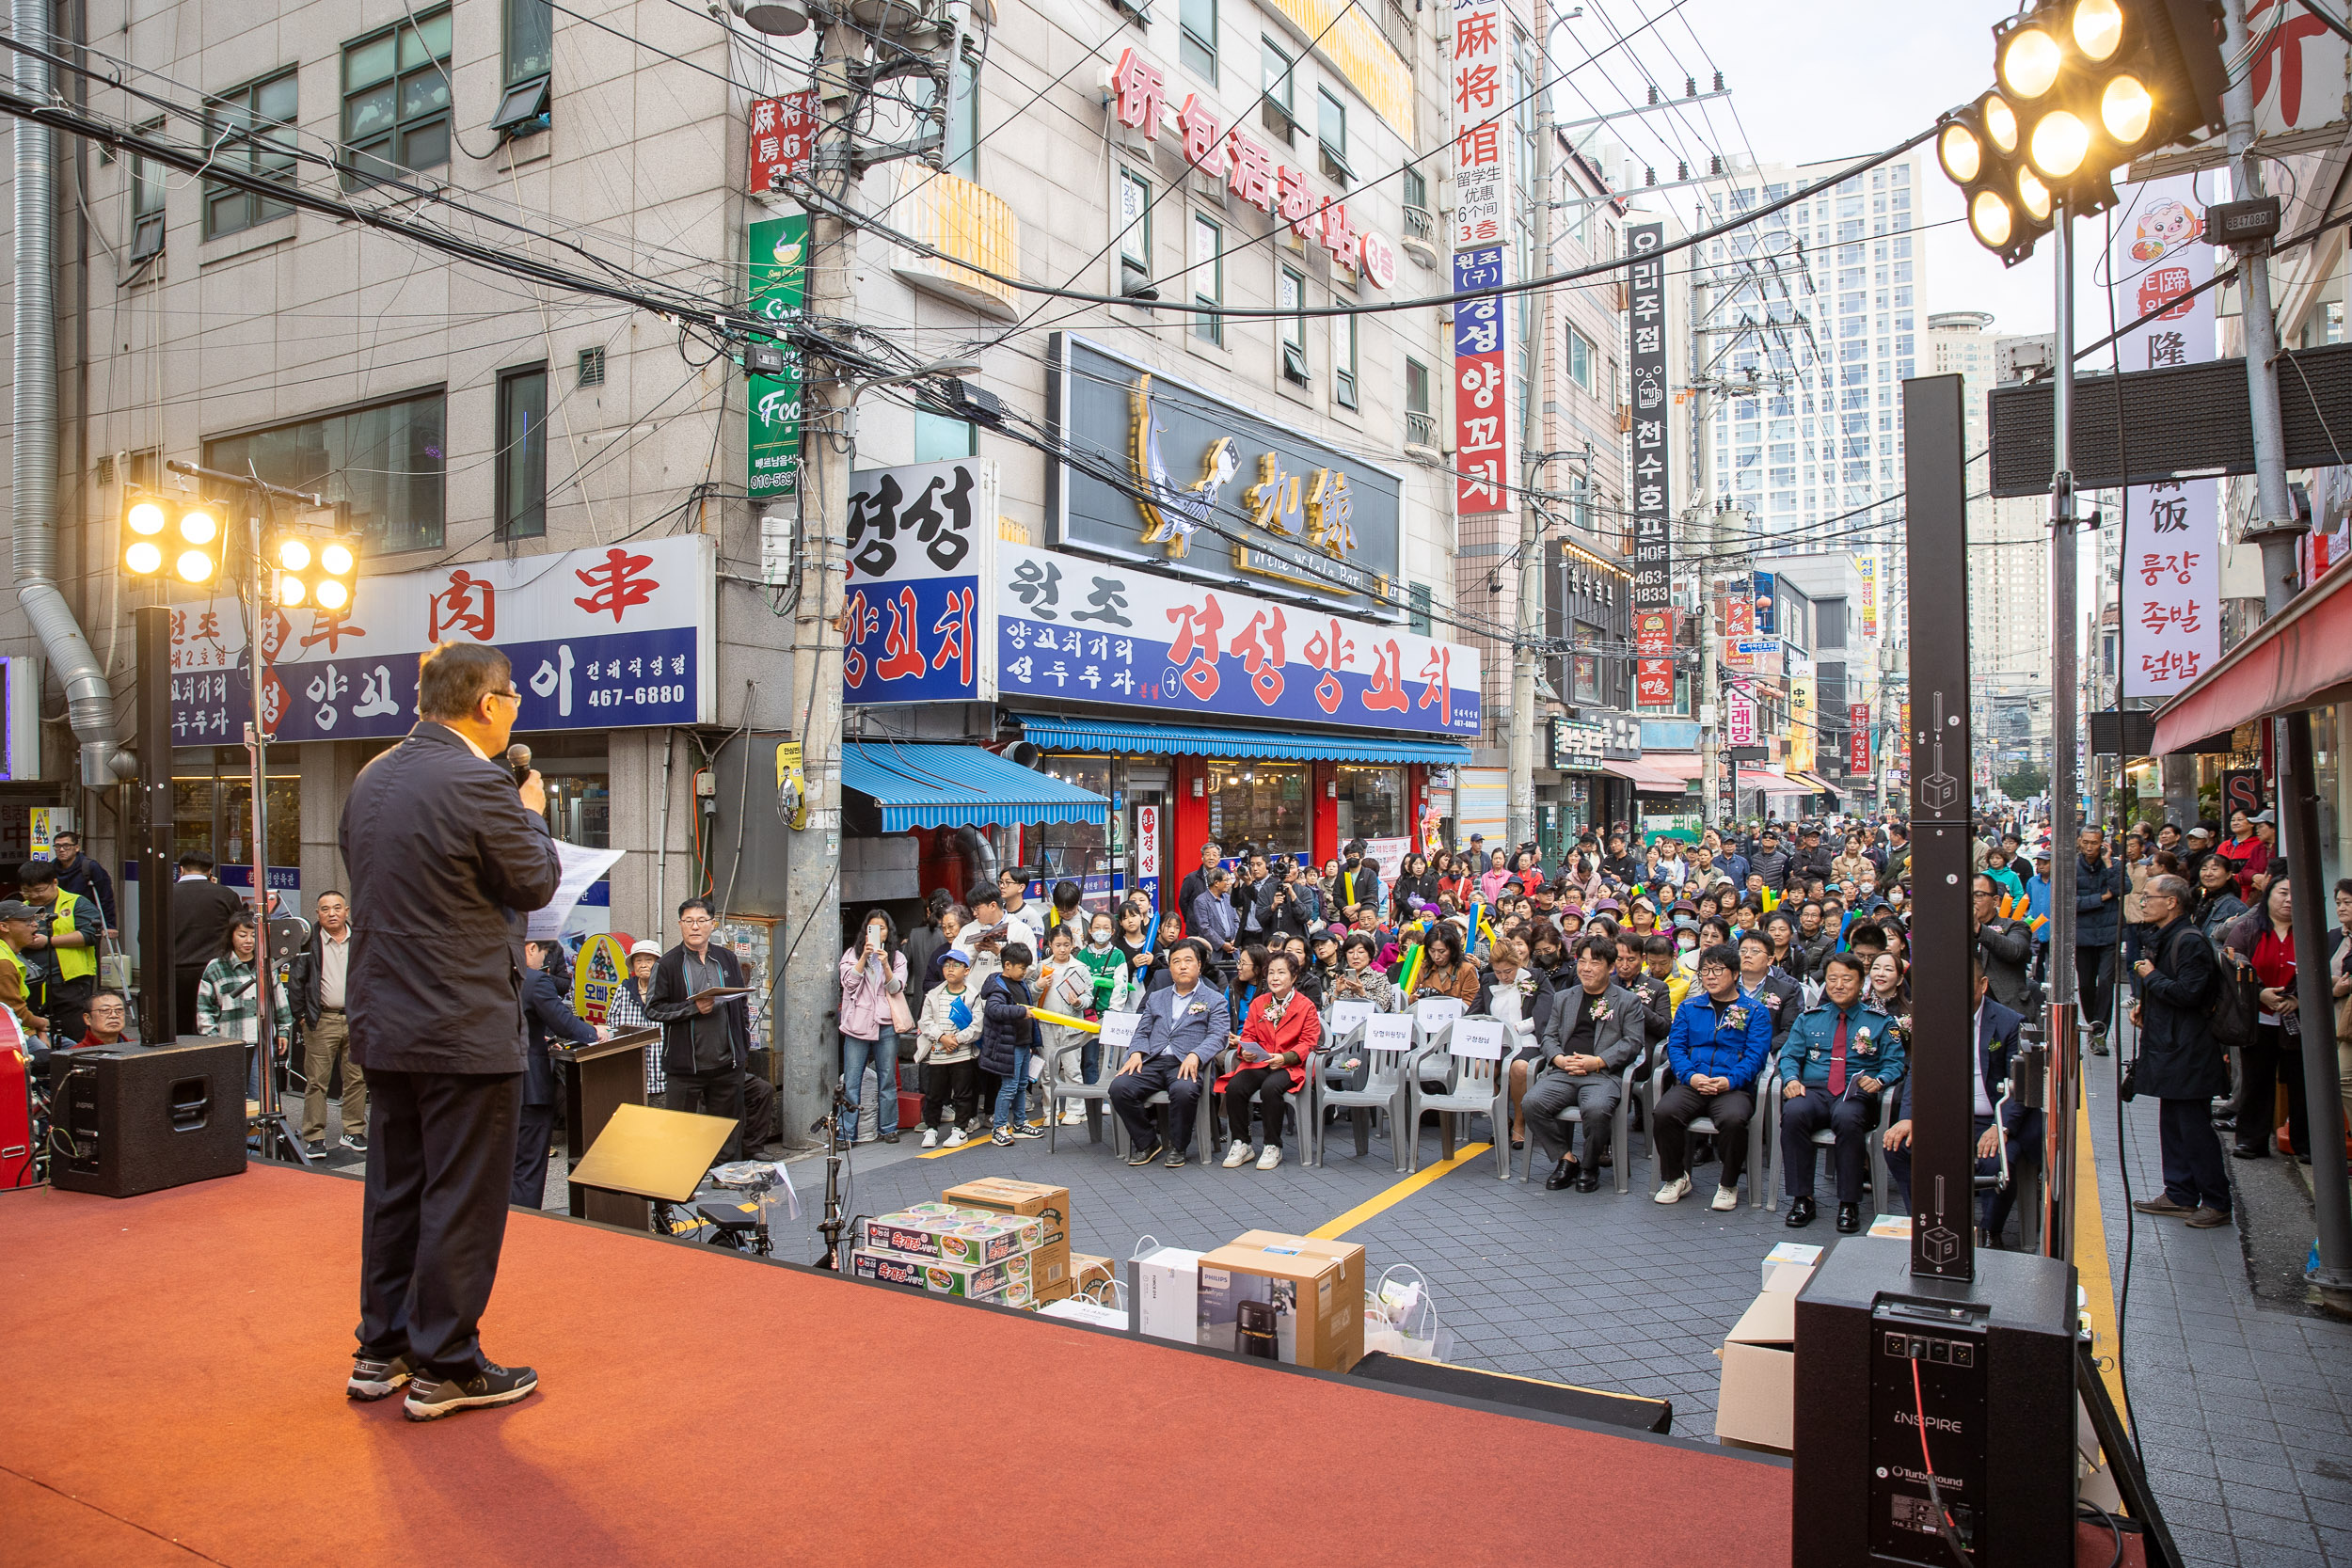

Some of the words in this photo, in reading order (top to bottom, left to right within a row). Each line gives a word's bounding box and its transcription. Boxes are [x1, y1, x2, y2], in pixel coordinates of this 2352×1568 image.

[1454, 11, 1501, 167] 麻将馆
[1456, 166, 1502, 188] 留学生
[1464, 185, 1496, 204] 优惠
[1460, 219, 1499, 242] 3층
[1455, 250, 1501, 268] 원조
[758, 388, 802, 428] Foo
[1460, 361, 1502, 506] 양꼬치
[1637, 420, 1663, 543] 천수호프
[1637, 546, 1667, 562] HOF
[1635, 569, 1669, 585] 463-
[1009, 560, 1134, 627] 원조
[1635, 587, 1669, 602] 1833
[2141, 599, 2201, 634] 족발
[844, 585, 975, 689] 양꼬치
[1007, 621, 1134, 665] 양꼬치거리
[1007, 656, 1136, 695] 선두주자
[2141, 650, 2201, 682] 덮밥
[588, 685, 686, 707] 467-6880
[1731, 674, 1753, 742] 노래방
[584, 983, 609, 1003] 오빠
[1039, 1209, 1057, 1219] ARBIN
[892, 1231, 921, 1251] 육개장
[878, 1262, 907, 1282] 육개장
[1204, 1274, 1228, 1283] PHILIPS
[1894, 1410, 1963, 1433] iNSPIRE
[1903, 1468, 1963, 1487] Turbsound
